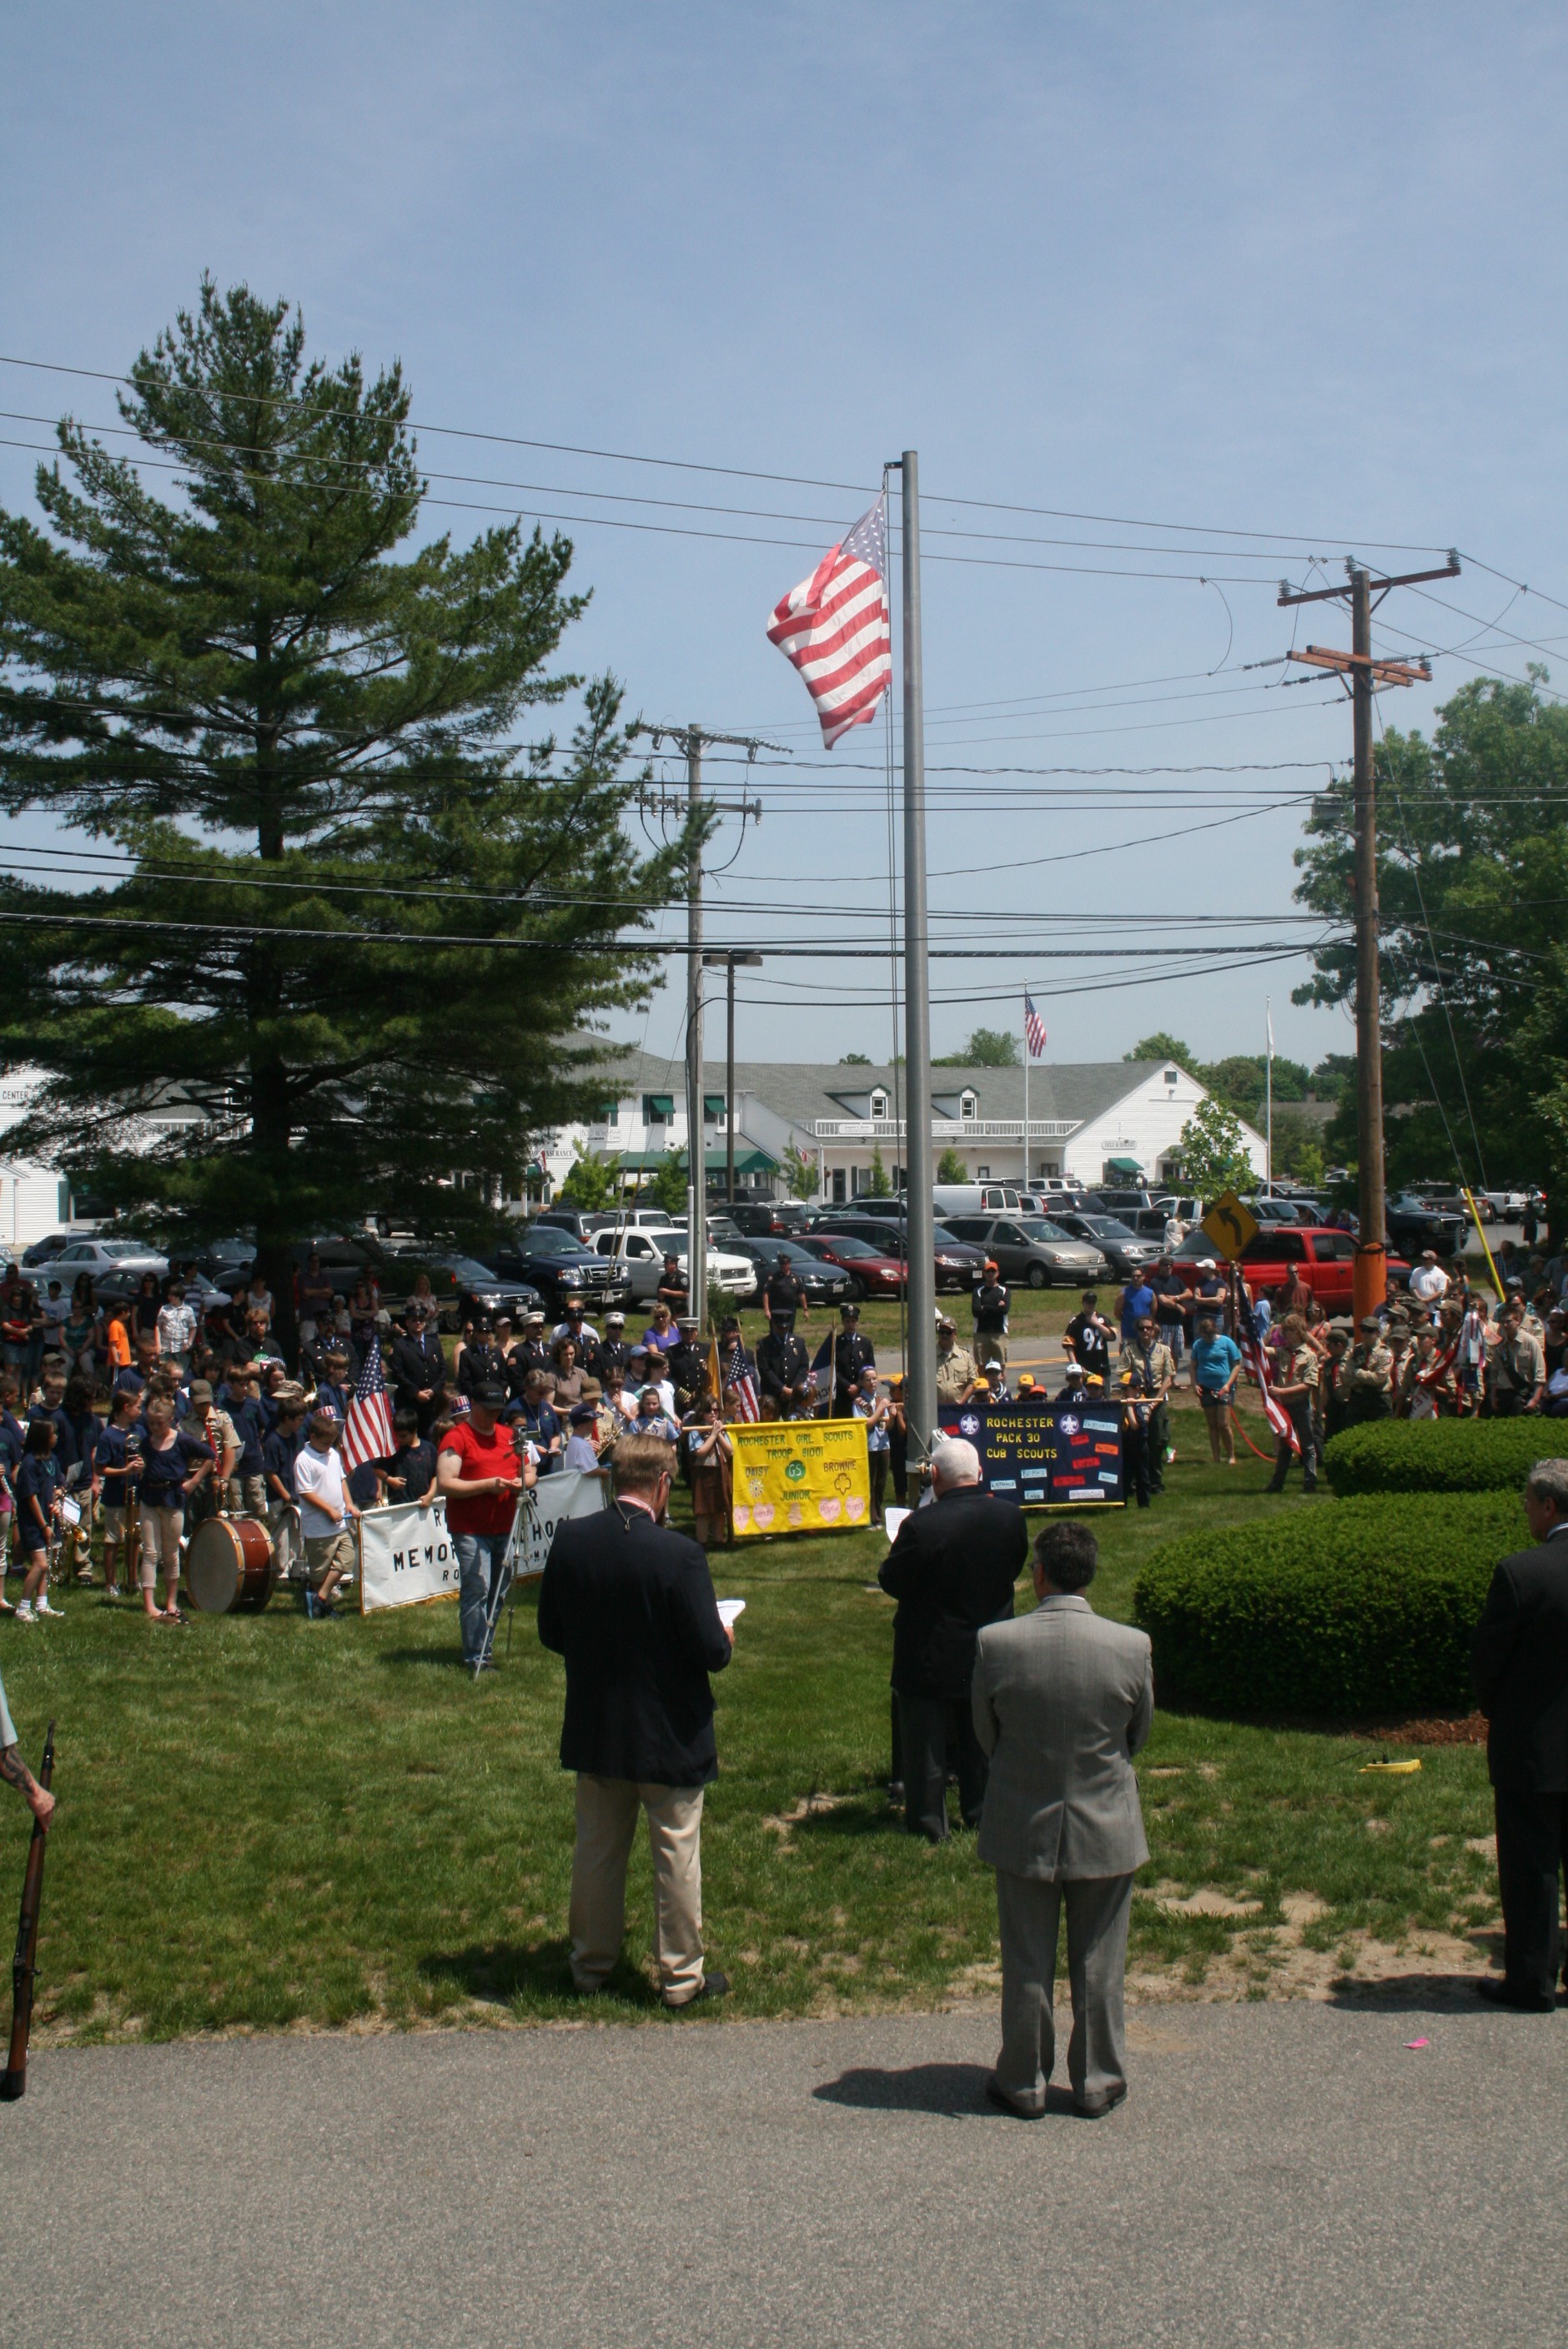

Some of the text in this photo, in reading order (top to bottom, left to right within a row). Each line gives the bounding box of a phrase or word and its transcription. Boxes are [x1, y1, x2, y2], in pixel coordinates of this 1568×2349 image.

[3, 1090, 29, 1099] CENTER
[987, 1418, 1054, 1428] ROCHESTER
[738, 1431, 853, 1447] ROCHESTER GIRL SCOUTS
[996, 1432, 1040, 1443] PACK 30
[766, 1448, 792, 1460] TROOP
[987, 1448, 1058, 1458] CUB SCOUTS
[746, 1466, 768, 1477] DAISY
[788, 1464, 802, 1477] GS
[823, 1461, 857, 1472] BROWNIE
[780, 1490, 811, 1501] JUNIOR
[393, 1542, 456, 1572] MEMOR
